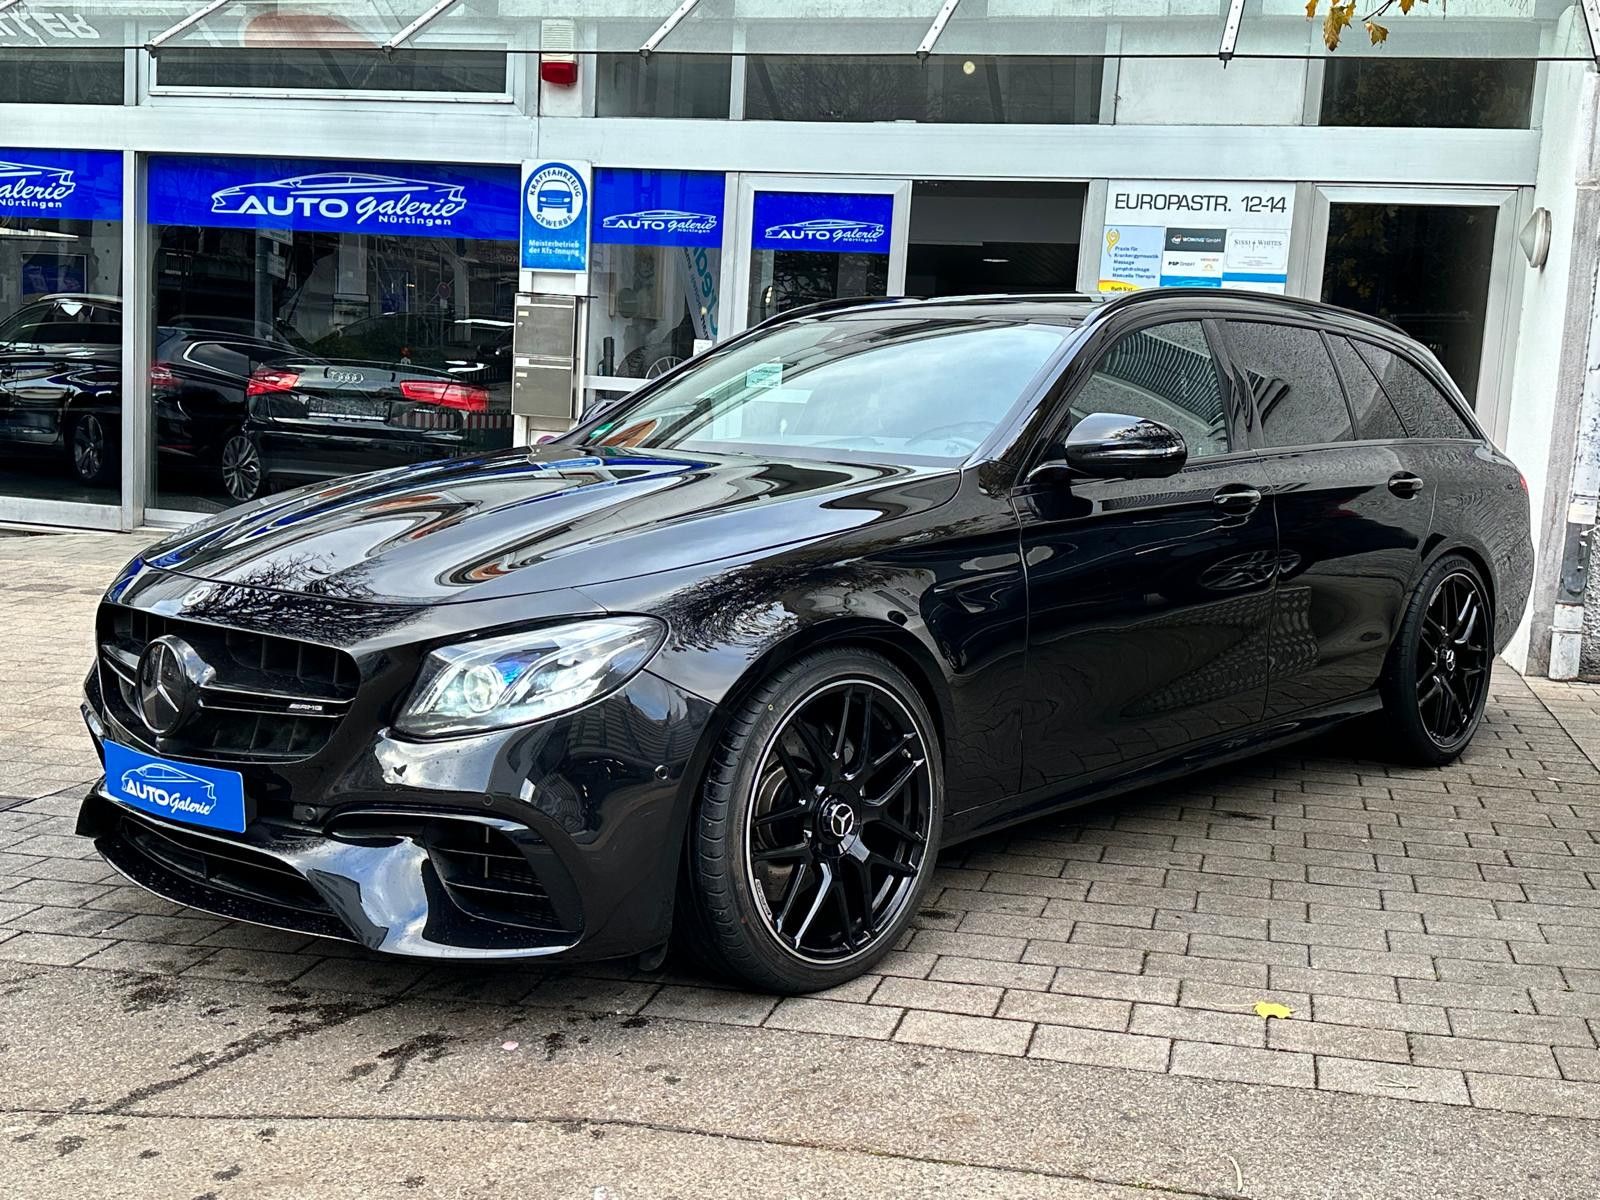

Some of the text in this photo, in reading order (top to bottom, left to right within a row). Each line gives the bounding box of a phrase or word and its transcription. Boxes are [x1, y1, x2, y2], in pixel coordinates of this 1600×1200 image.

[0, 178, 67, 200] alerie
[529, 169, 581, 197] KRAFTFAHRZEUG
[238, 195, 348, 218] AUTO
[1114, 193, 1287, 213] EUROPASTR. 12-14
[378, 215, 452, 227] Nürtingen
[536, 213, 573, 227] GEWERBE
[615, 219, 665, 230] AUTO
[779, 229, 830, 240] AUTO
[528, 239, 580, 247] Meisterbetrieb
[528, 247, 540, 255] der
[126, 779, 170, 806] AUTO
